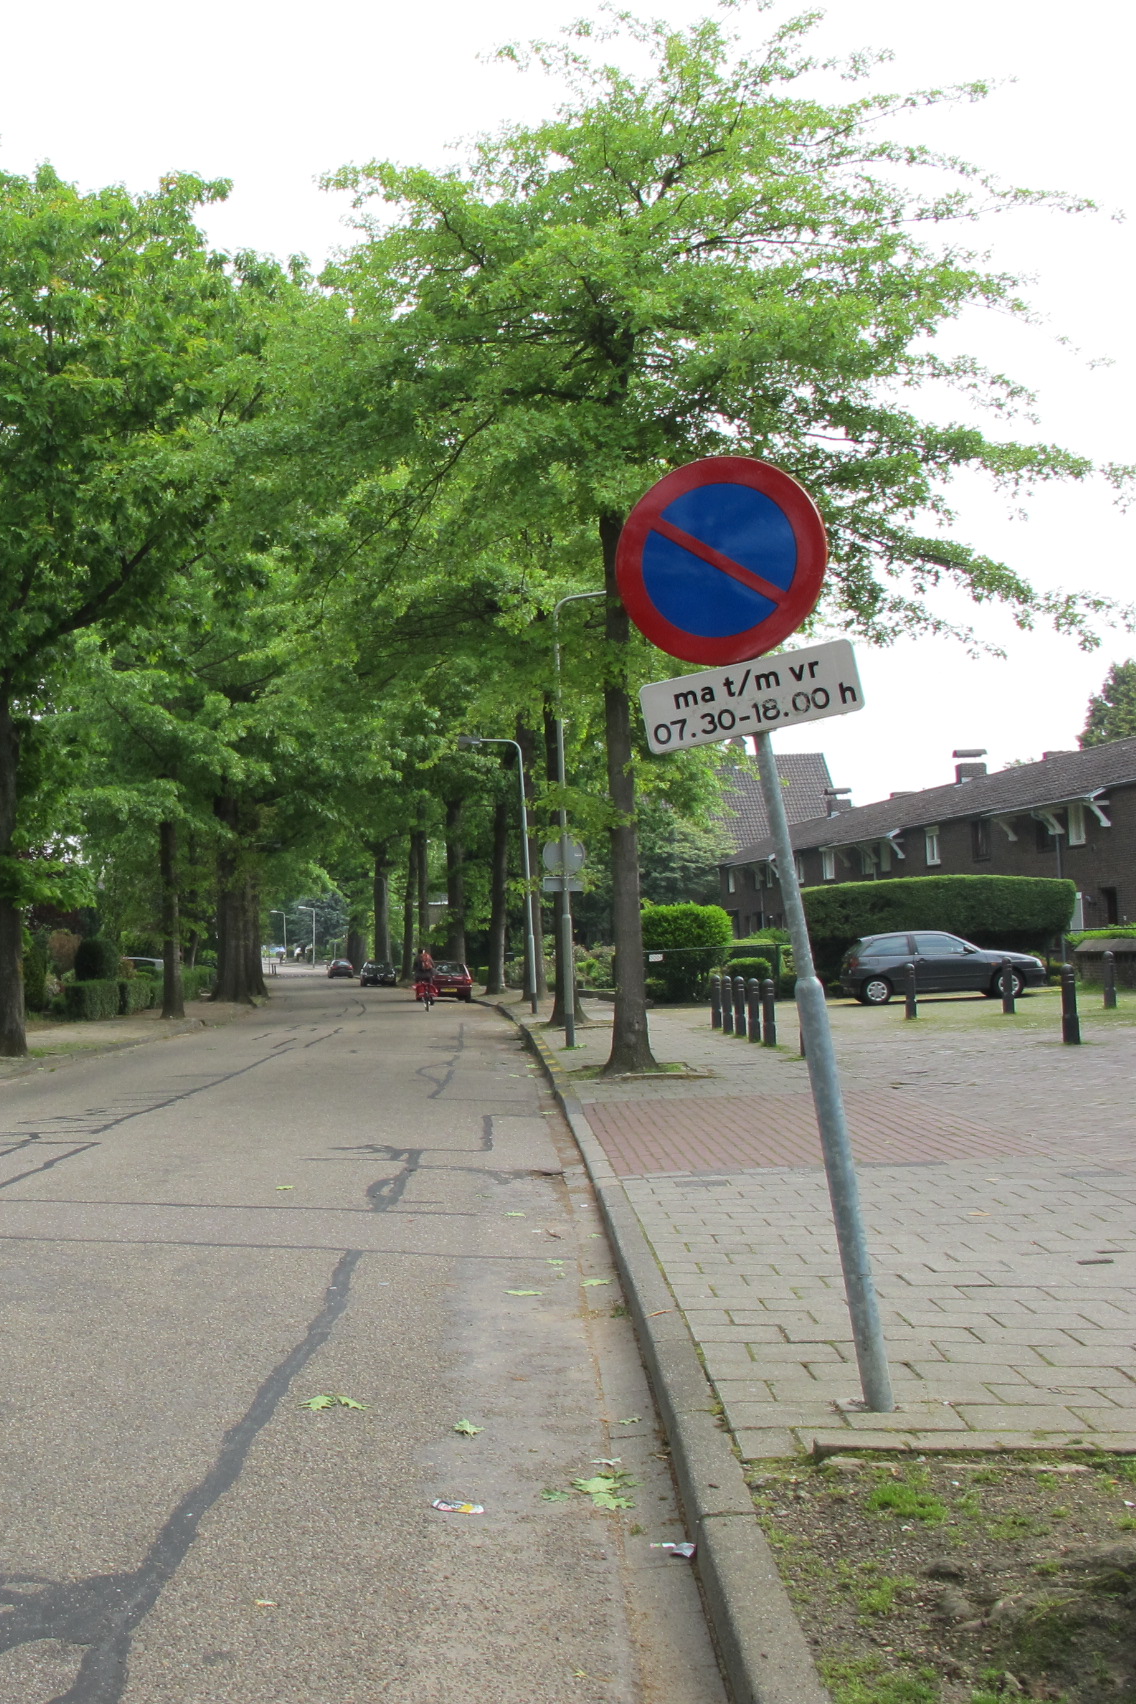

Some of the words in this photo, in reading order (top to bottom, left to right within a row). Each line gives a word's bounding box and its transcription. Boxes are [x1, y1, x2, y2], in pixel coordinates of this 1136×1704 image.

[673, 686, 715, 710] ma
[723, 669, 780, 697] t/m
[789, 660, 819, 682] vr
[654, 687, 830, 745] 07.30-18.00
[838, 682, 857, 704] h
